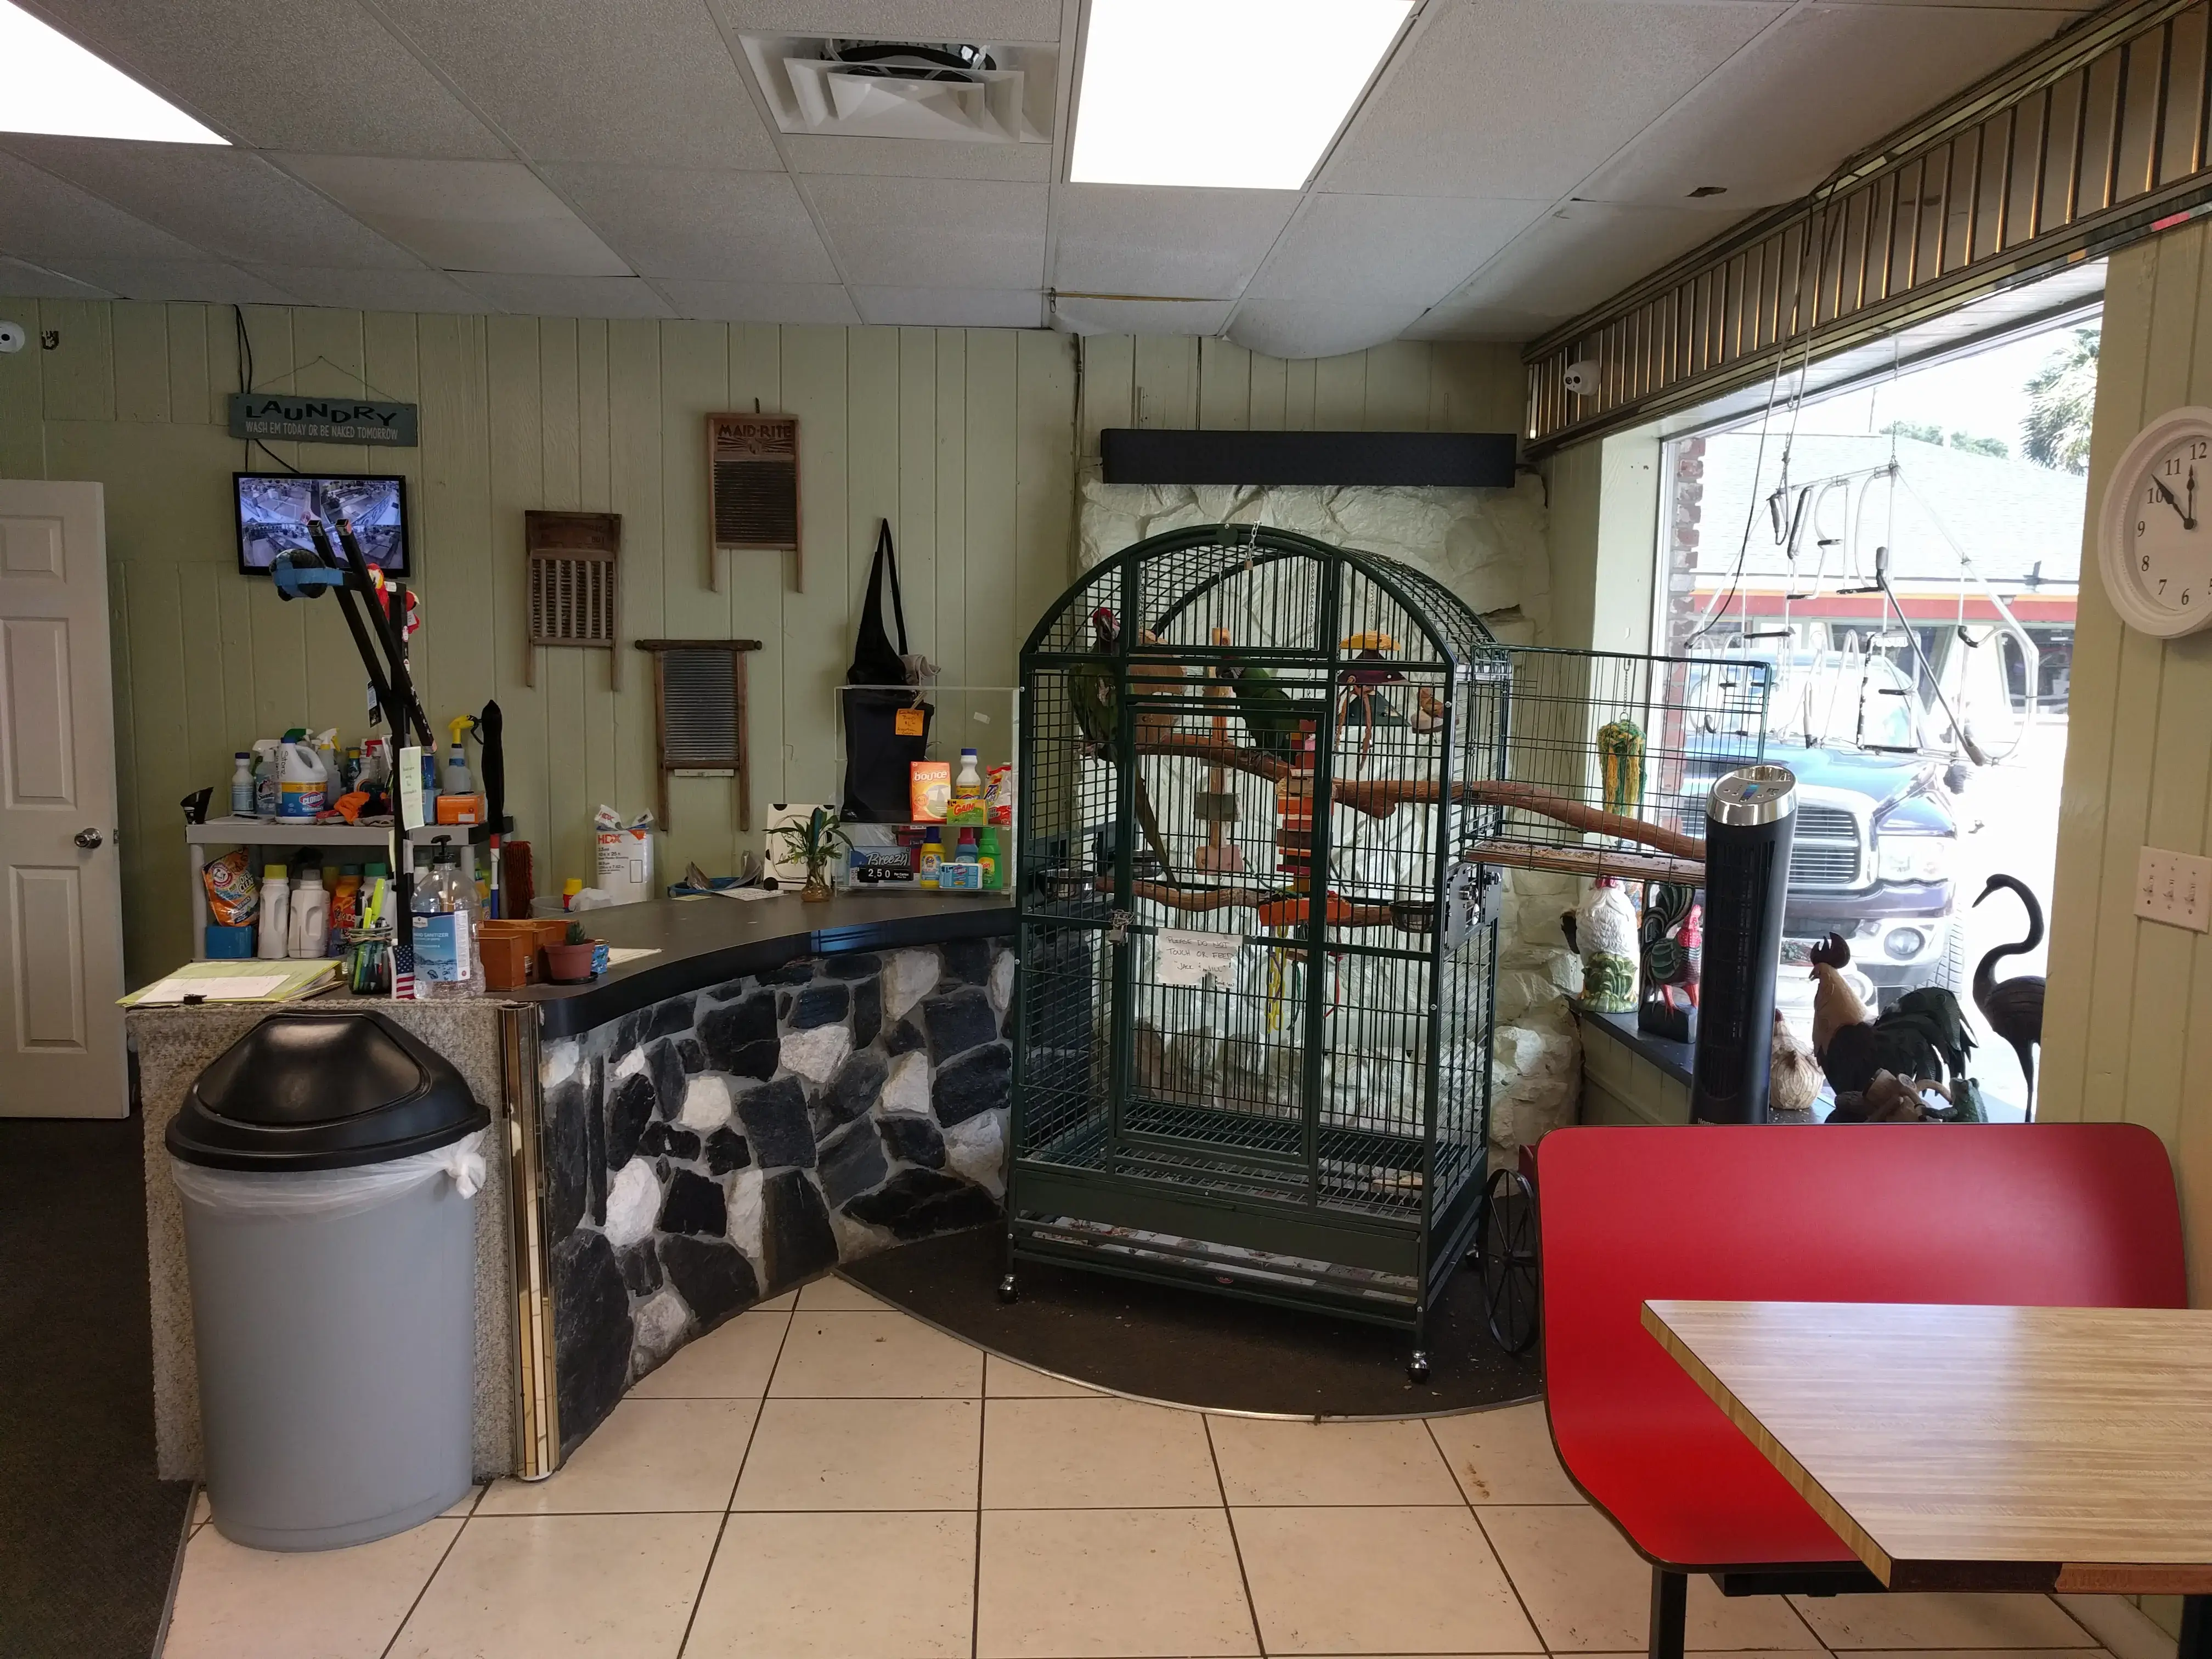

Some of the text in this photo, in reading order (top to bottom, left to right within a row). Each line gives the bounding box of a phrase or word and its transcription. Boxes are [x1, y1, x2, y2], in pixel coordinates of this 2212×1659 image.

[246, 400, 397, 427] LAUNDRY
[246, 421, 398, 441] WASH EM TODAY OR BE NAKED TOMORROW
[2190, 441, 2208, 460] 12
[2165, 459, 2181, 476] 11
[2147, 487, 2164, 504] 10
[2137, 521, 2146, 537] 9
[2141, 555, 2150, 572] 8
[2158, 579, 2168, 595] 7
[2181, 588, 2190, 605] 6
[914, 771, 947, 781] bounce
[303, 794, 324, 804] CLOROX
[953, 803, 975, 816] GAIN
[598, 834, 622, 844] HDX
[868, 868, 890, 878] 2.50
[1166, 936, 1192, 945] PLEASE
